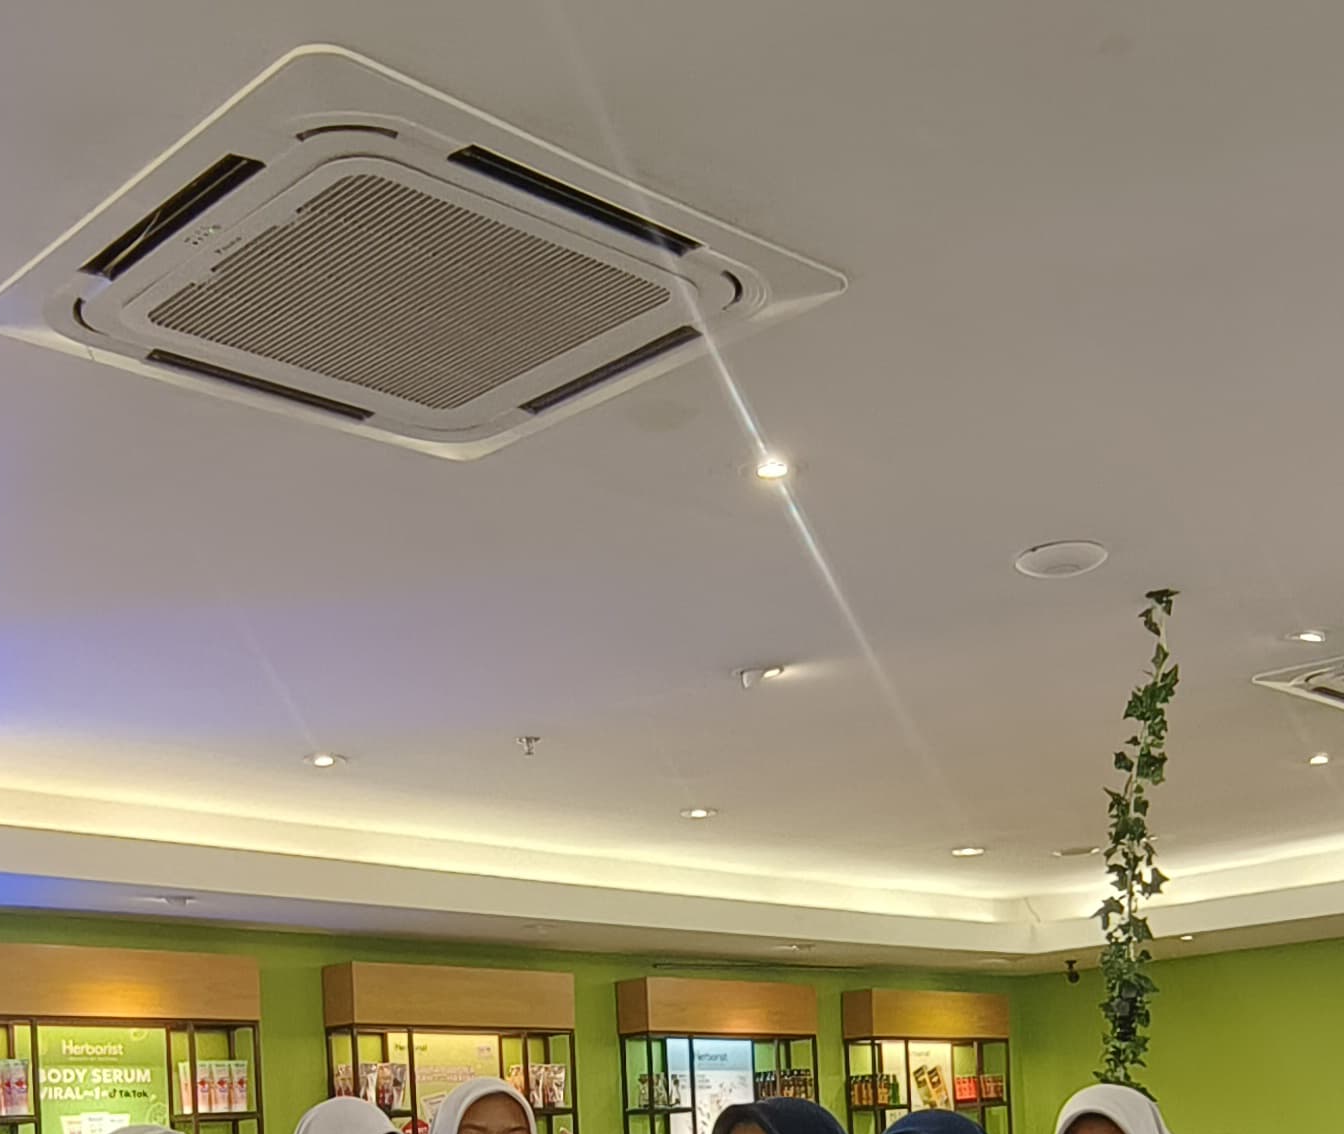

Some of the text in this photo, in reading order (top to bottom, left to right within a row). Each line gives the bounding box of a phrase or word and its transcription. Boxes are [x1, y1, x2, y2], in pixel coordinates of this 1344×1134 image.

[61, 1039, 124, 1056] Herborist
[91, 1067, 153, 1084] SERUM
[39, 1086, 84, 1101] VIRAL
